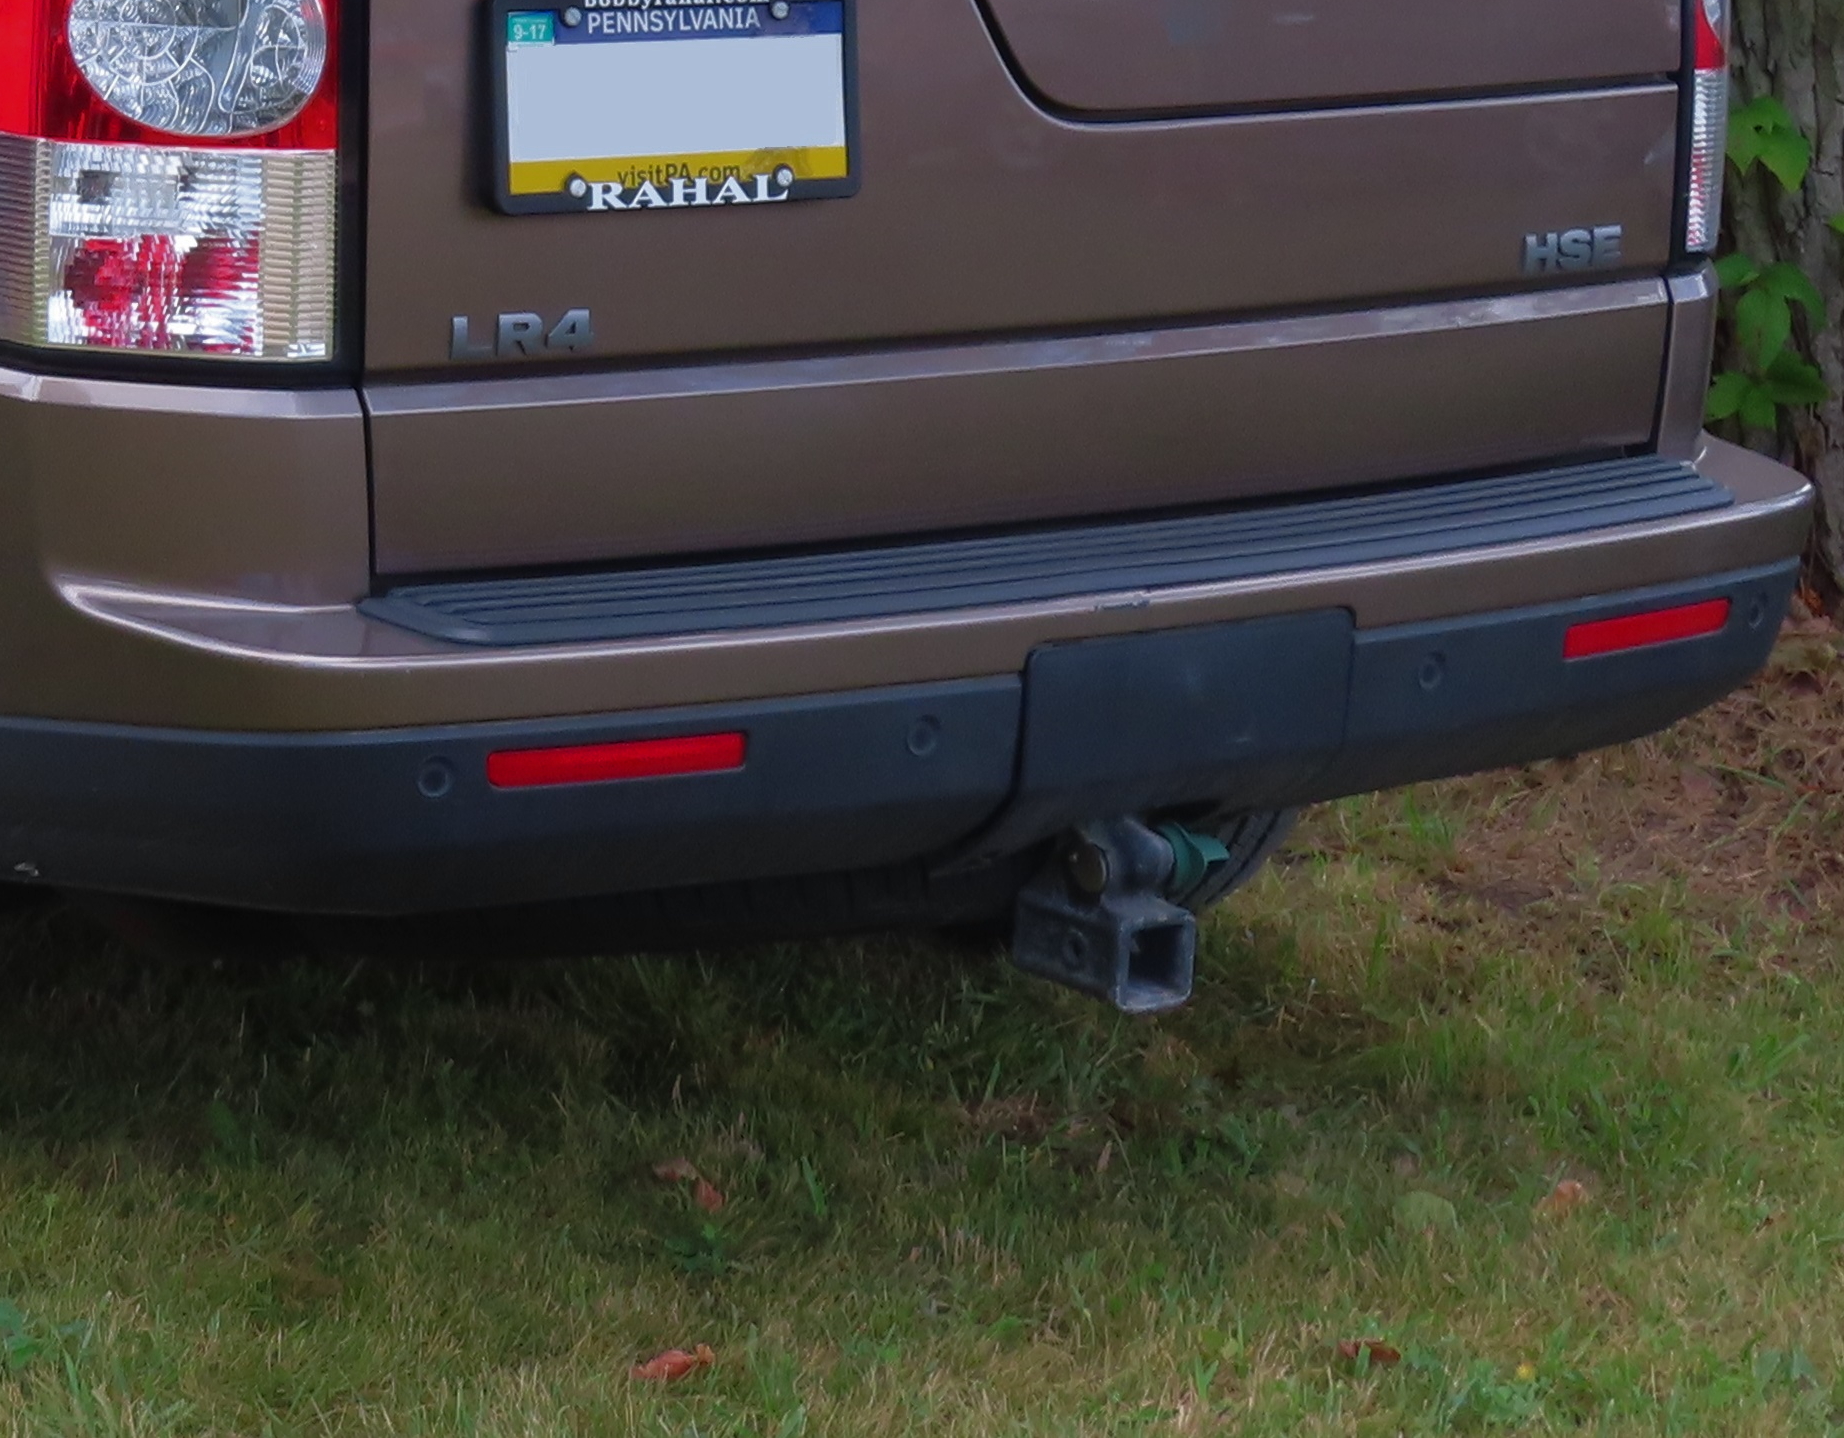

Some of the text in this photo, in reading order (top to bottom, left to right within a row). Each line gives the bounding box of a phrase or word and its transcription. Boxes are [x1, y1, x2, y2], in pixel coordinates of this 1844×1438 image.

[513, 24, 546, 41] 9-17
[587, 7, 761, 34] PENNSYLVANIA
[617, 162, 741, 187] visitPAcom
[586, 173, 789, 211] RAHAL
[1524, 225, 1622, 273] HSE
[451, 308, 593, 360] LR4
